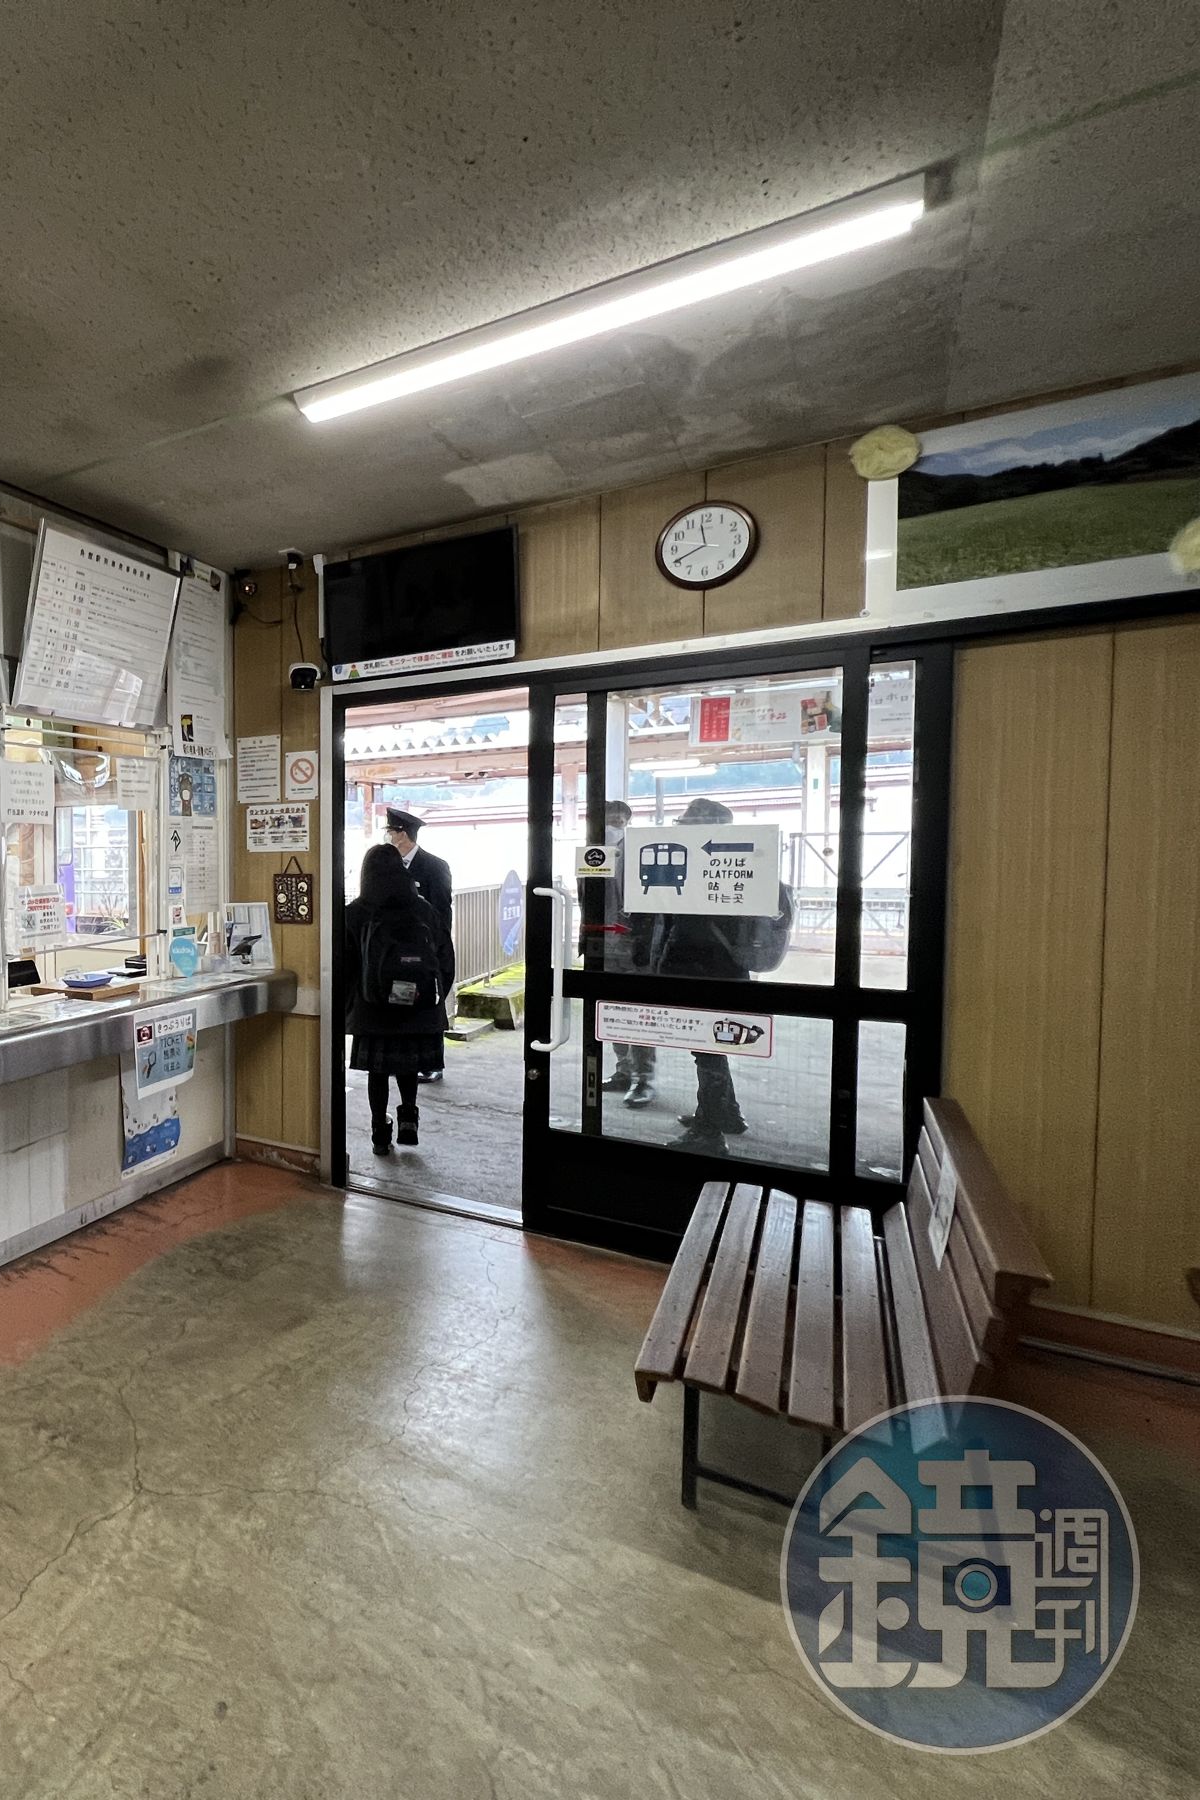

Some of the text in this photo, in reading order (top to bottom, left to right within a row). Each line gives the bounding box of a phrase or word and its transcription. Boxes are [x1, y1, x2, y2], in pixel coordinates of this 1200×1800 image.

[701, 513, 712, 523] 12
[720, 514, 724, 524] 1
[686, 519, 694, 530] 11
[730, 522, 737, 532] 2
[674, 531, 685, 541] 10
[734, 534, 741, 545] 3
[671, 545, 678, 555] 9
[729, 548, 736, 558] 4
[686, 565, 693, 575] 7
[717, 560, 724, 570] 5
[701, 566, 708, 577] 6
[710, 857, 746, 867] のりば
[703, 870, 753, 879] PLATFORM
[708, 893, 744, 904] 타는곳
[157, 1015, 191, 1033] きっぷうりば
[160, 1033, 184, 1048] TICKET
